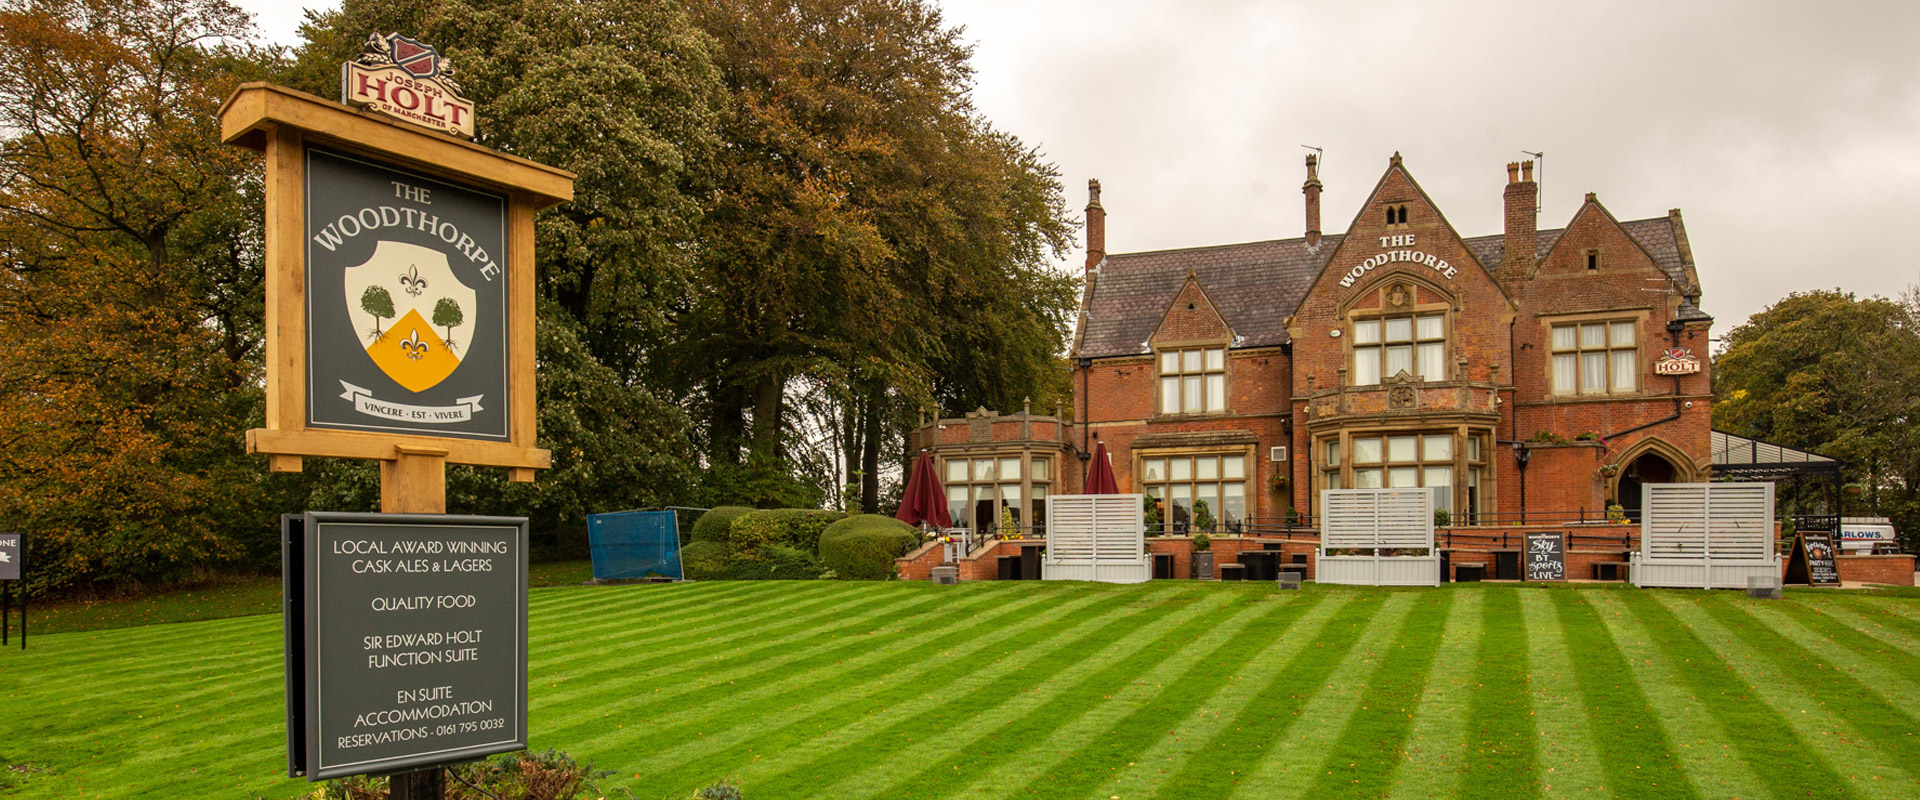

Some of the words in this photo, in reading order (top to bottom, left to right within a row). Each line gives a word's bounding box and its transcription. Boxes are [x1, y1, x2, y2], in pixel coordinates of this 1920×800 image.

[385, 72, 442, 98] JOSEPH
[357, 72, 469, 126] HOLT
[394, 107, 446, 128] MANCHESTER
[391, 181, 431, 205] THE
[313, 206, 500, 282] WOODTHORPE
[1379, 234, 1416, 248] THE
[1339, 250, 1458, 288] WOODTHORPE
[1658, 362, 1698, 372] HOLT
[364, 402, 403, 417] VINCERE
[411, 411, 426, 420] EST
[434, 410, 464, 420] VIVERE
[333, 540, 388, 554] LOCAL
[391, 541, 443, 554] AWARD
[446, 541, 507, 554] WINNING
[1531, 540, 1557, 552] Sky
[352, 559, 392, 573] CASK
[395, 559, 429, 573] ALES
[432, 562, 440, 572] &
[444, 559, 492, 572] LAGERS
[1535, 554, 1549, 562] BT
[371, 596, 434, 611] QUALITY
[437, 595, 476, 609] FOOD
[363, 635, 382, 650] SIR
[386, 633, 443, 649] EDWARD
[446, 630, 483, 644] HOLT
[368, 651, 442, 669] FUNCTION
[445, 648, 478, 663] SUITE
[397, 690, 415, 704] EN
[419, 686, 453, 702] SUITE
[354, 700, 492, 728] ACCOMMODATION
[338, 726, 428, 749] RESERVATIONS
[436, 724, 456, 736] 0161
[459, 721, 477, 733] 795
[480, 718, 505, 731] 0032
